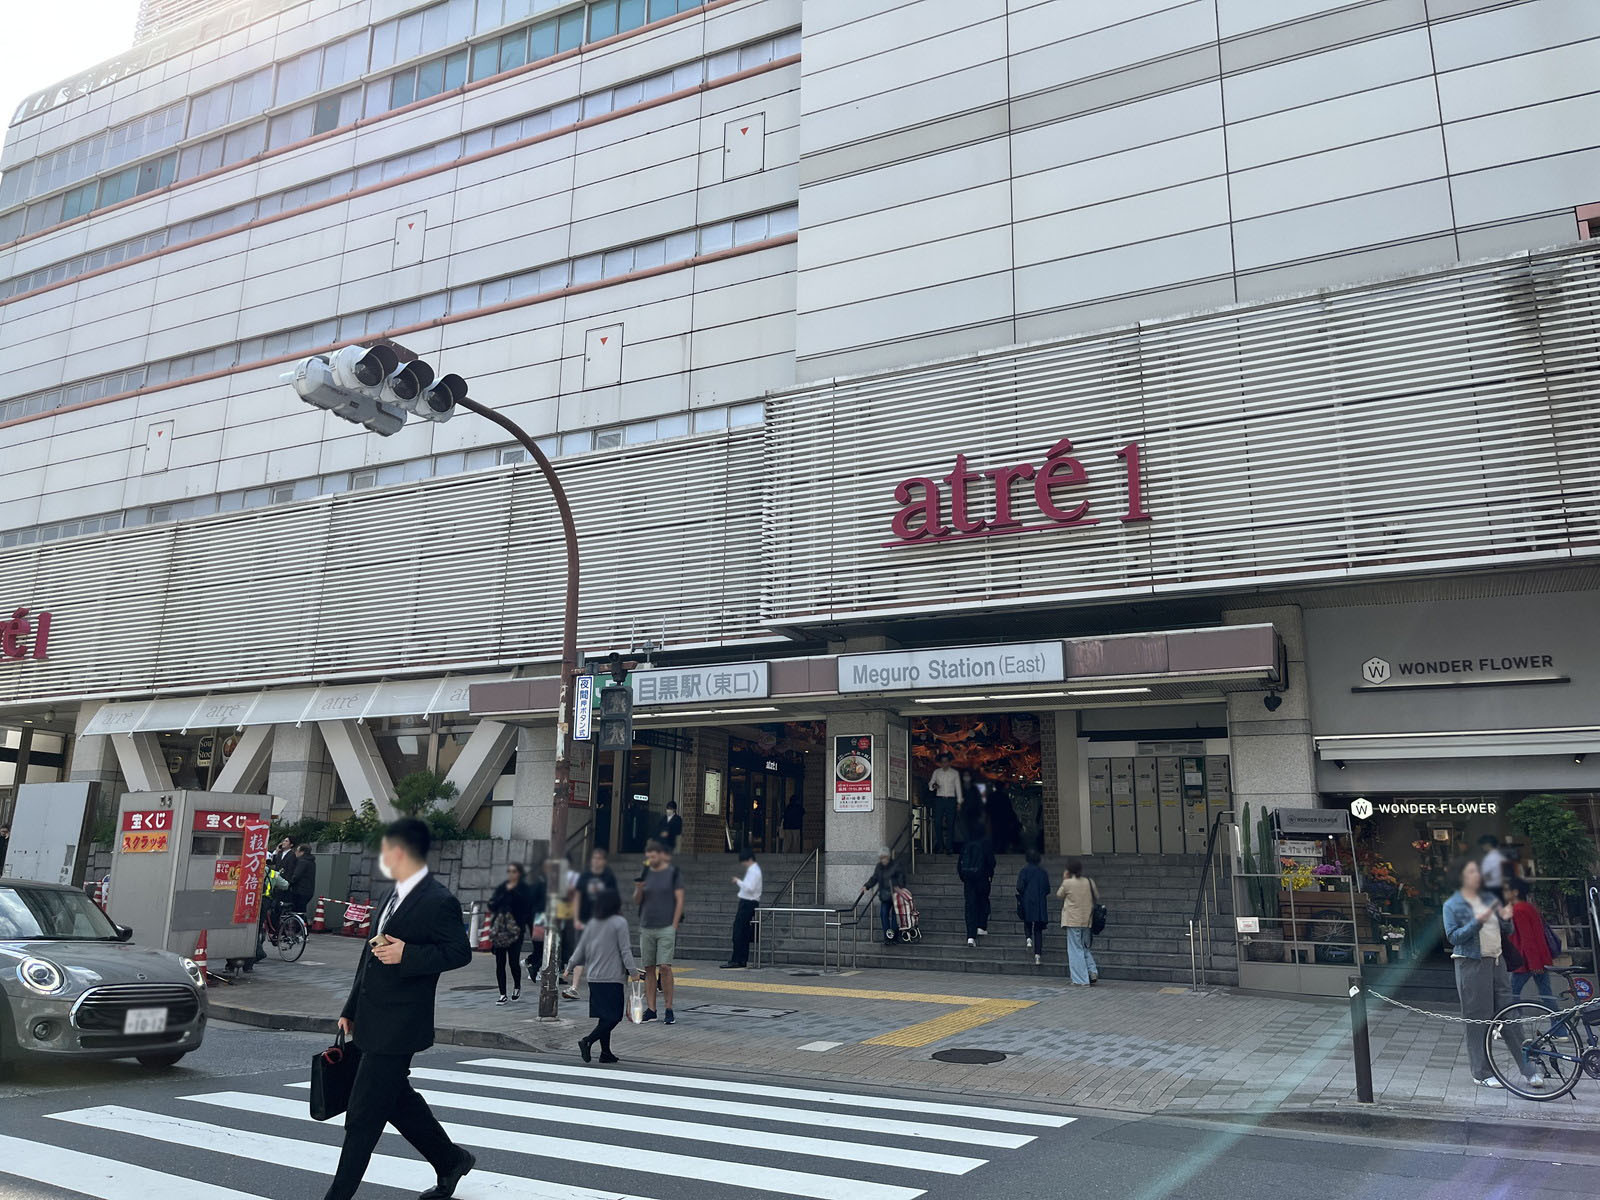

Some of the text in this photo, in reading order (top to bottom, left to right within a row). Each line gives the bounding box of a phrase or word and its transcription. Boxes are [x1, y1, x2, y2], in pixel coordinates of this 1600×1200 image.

[890, 438, 1153, 540] atré 1
[853, 652, 1047, 687] Meguro Station (East)
[1398, 659, 1473, 675] WONDER
[1479, 655, 1554, 671] FLOWER
[638, 669, 760, 702] 目黒駅(東口)
[1378, 803, 1436, 814] WONDER
[1439, 803, 1497, 814] FLOWER
[131, 812, 166, 829] 宝くじ
[206, 813, 248, 829] 宝くじ
[123, 835, 168, 850] スクラッチ
[244, 823, 269, 907] 一粒万倍日
